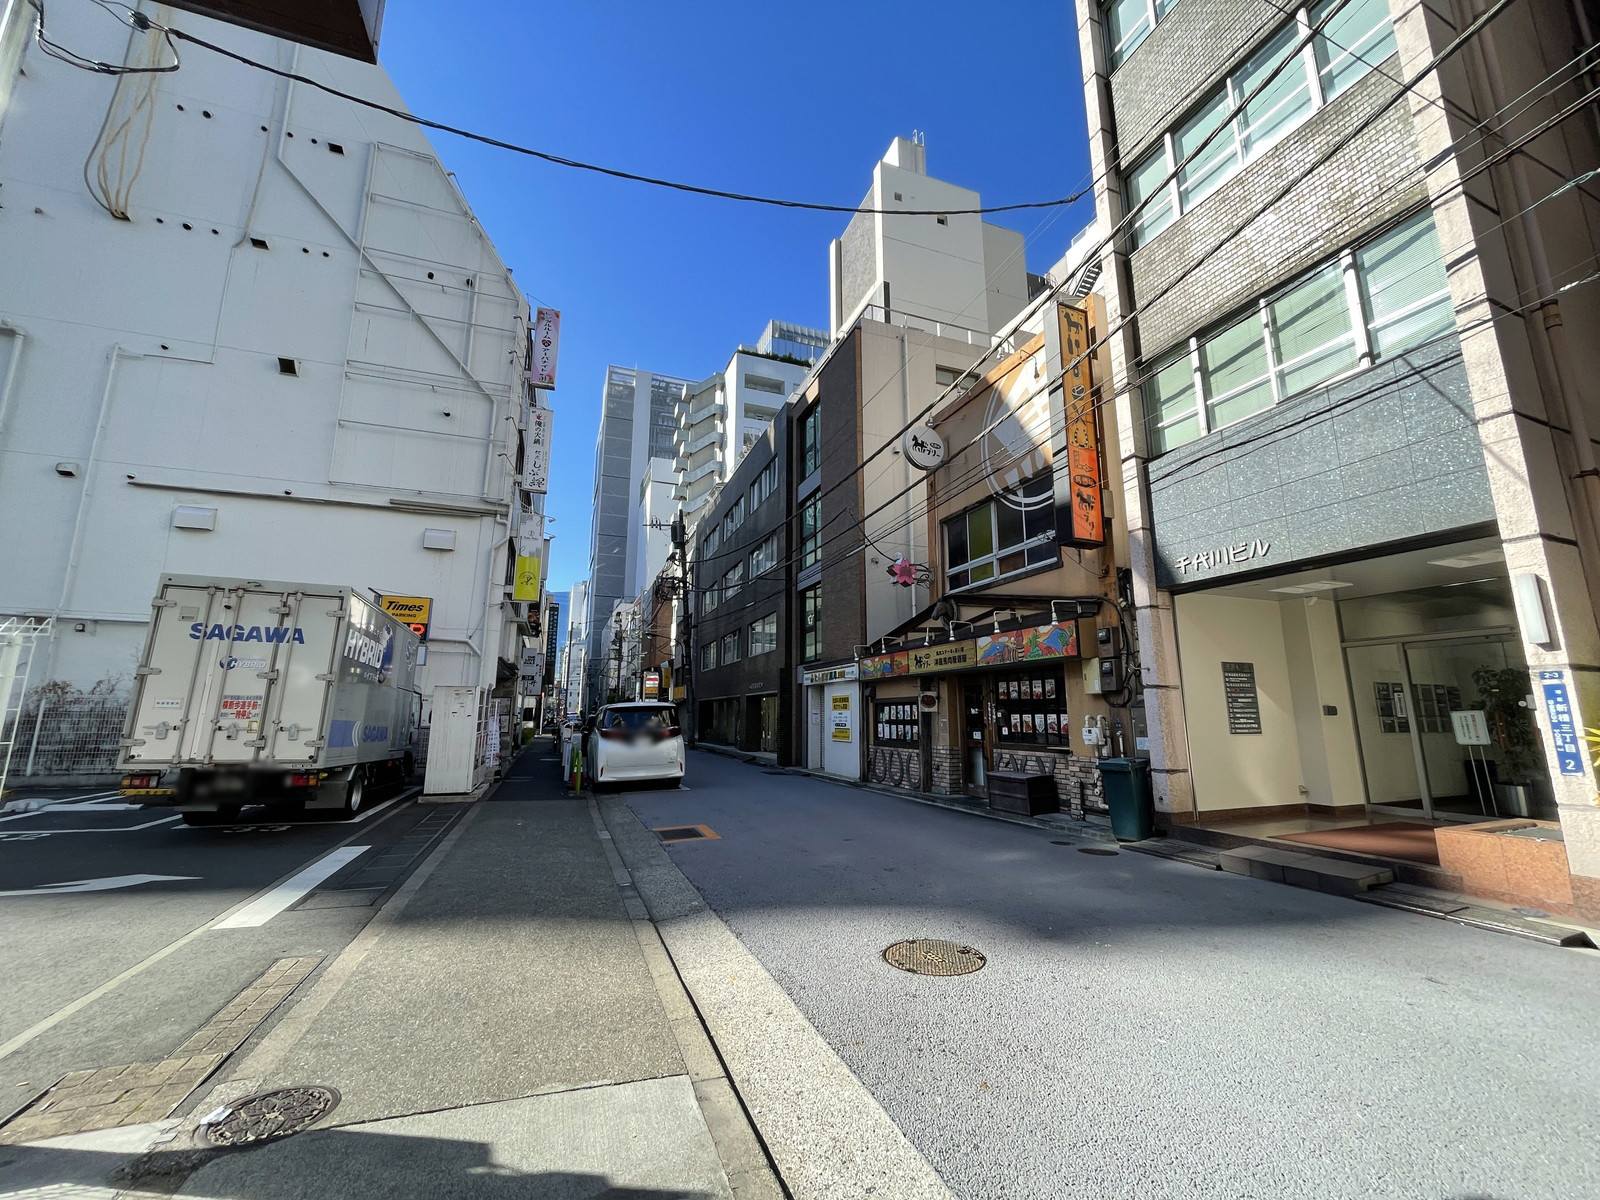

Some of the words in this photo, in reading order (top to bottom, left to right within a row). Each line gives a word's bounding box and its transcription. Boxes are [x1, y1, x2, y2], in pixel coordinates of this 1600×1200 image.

[1175, 539, 1271, 575] 千代川ビル
[385, 600, 425, 612] Times
[189, 622, 305, 645] SAGAWA
[343, 628, 384, 669] HYBRID
[230, 660, 267, 669] HYBRID
[1564, 759, 1577, 770] 2
